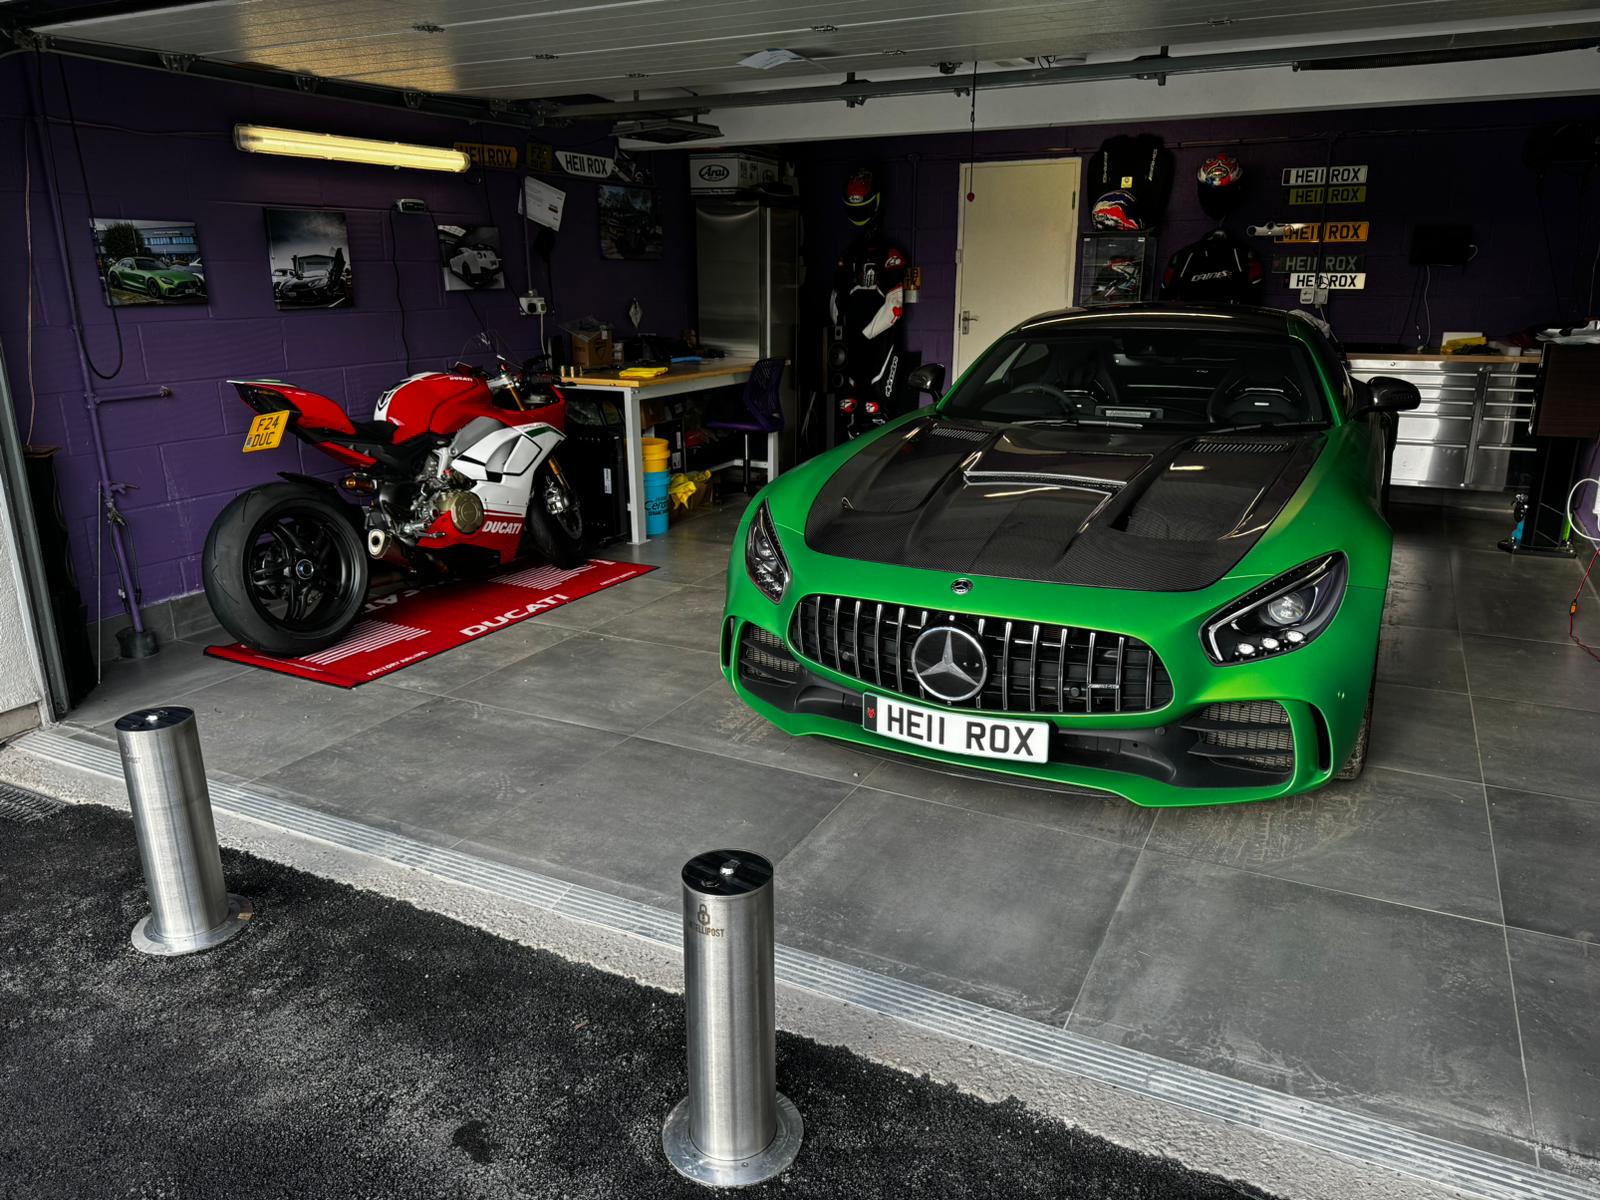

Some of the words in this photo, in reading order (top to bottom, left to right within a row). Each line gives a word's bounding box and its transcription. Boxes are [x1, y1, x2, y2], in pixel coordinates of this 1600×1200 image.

[487, 148, 512, 167] ROX
[588, 159, 607, 175] ROX
[1330, 168, 1361, 182] ROX
[1330, 187, 1360, 201] ROX
[1328, 223, 1361, 240] ROX
[1325, 255, 1358, 272] ROX
[1329, 274, 1358, 287] ROX
[256, 415, 280, 432] F24
[251, 431, 275, 447] DUC
[482, 520, 522, 535] DUCATI
[459, 593, 570, 637] DUCATI
[965, 720, 1034, 757] ROX
[687, 919, 725, 938] TELLIPOST
